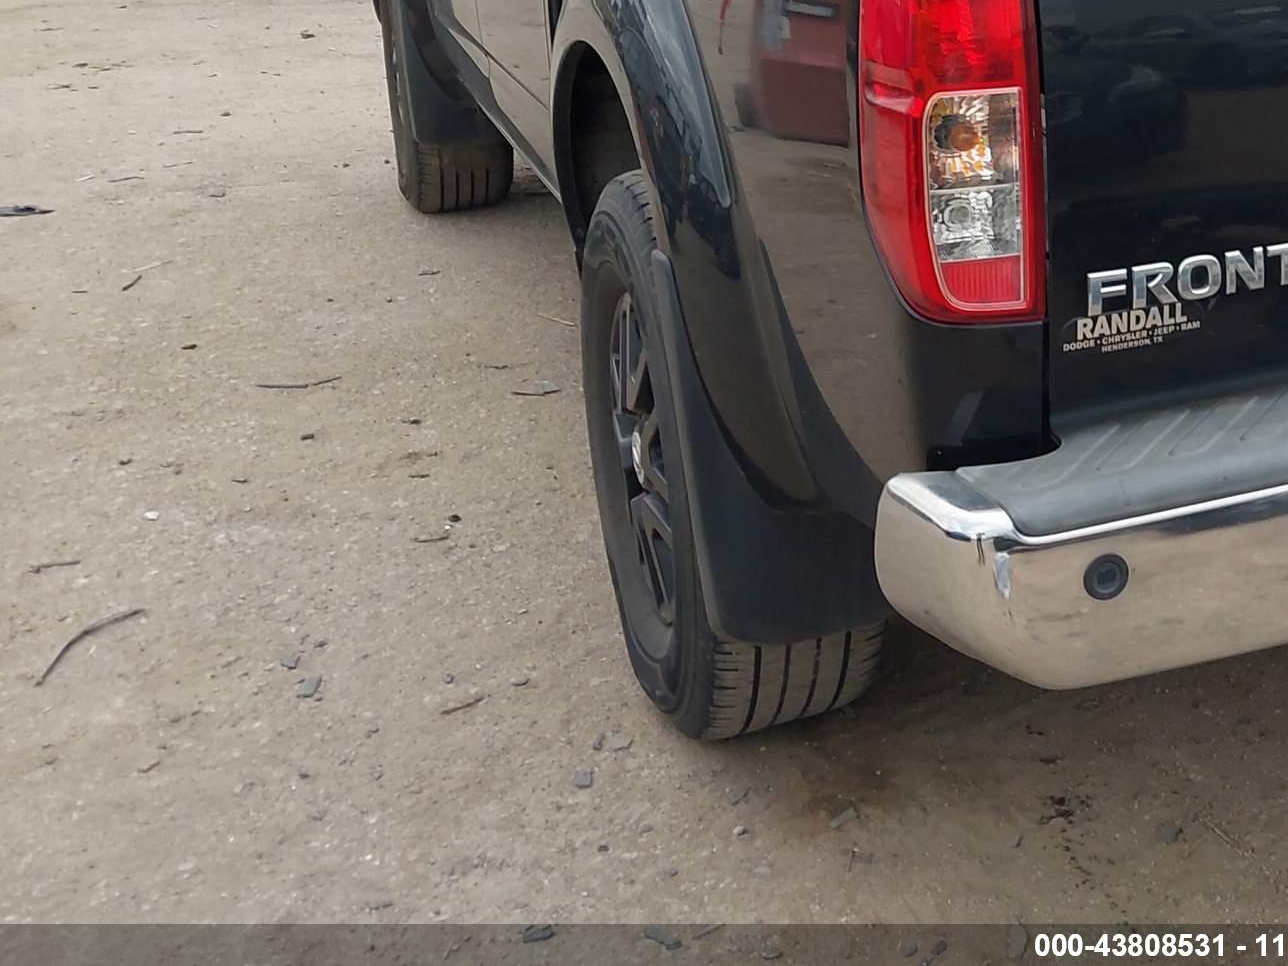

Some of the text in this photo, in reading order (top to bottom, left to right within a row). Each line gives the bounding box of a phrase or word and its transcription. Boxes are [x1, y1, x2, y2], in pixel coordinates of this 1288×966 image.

[1063, 320, 1200, 352] DODGE CHRYSLER JEEP RAM
[1077, 302, 1188, 341] RANDALL
[1153, 336, 1164, 344] TX
